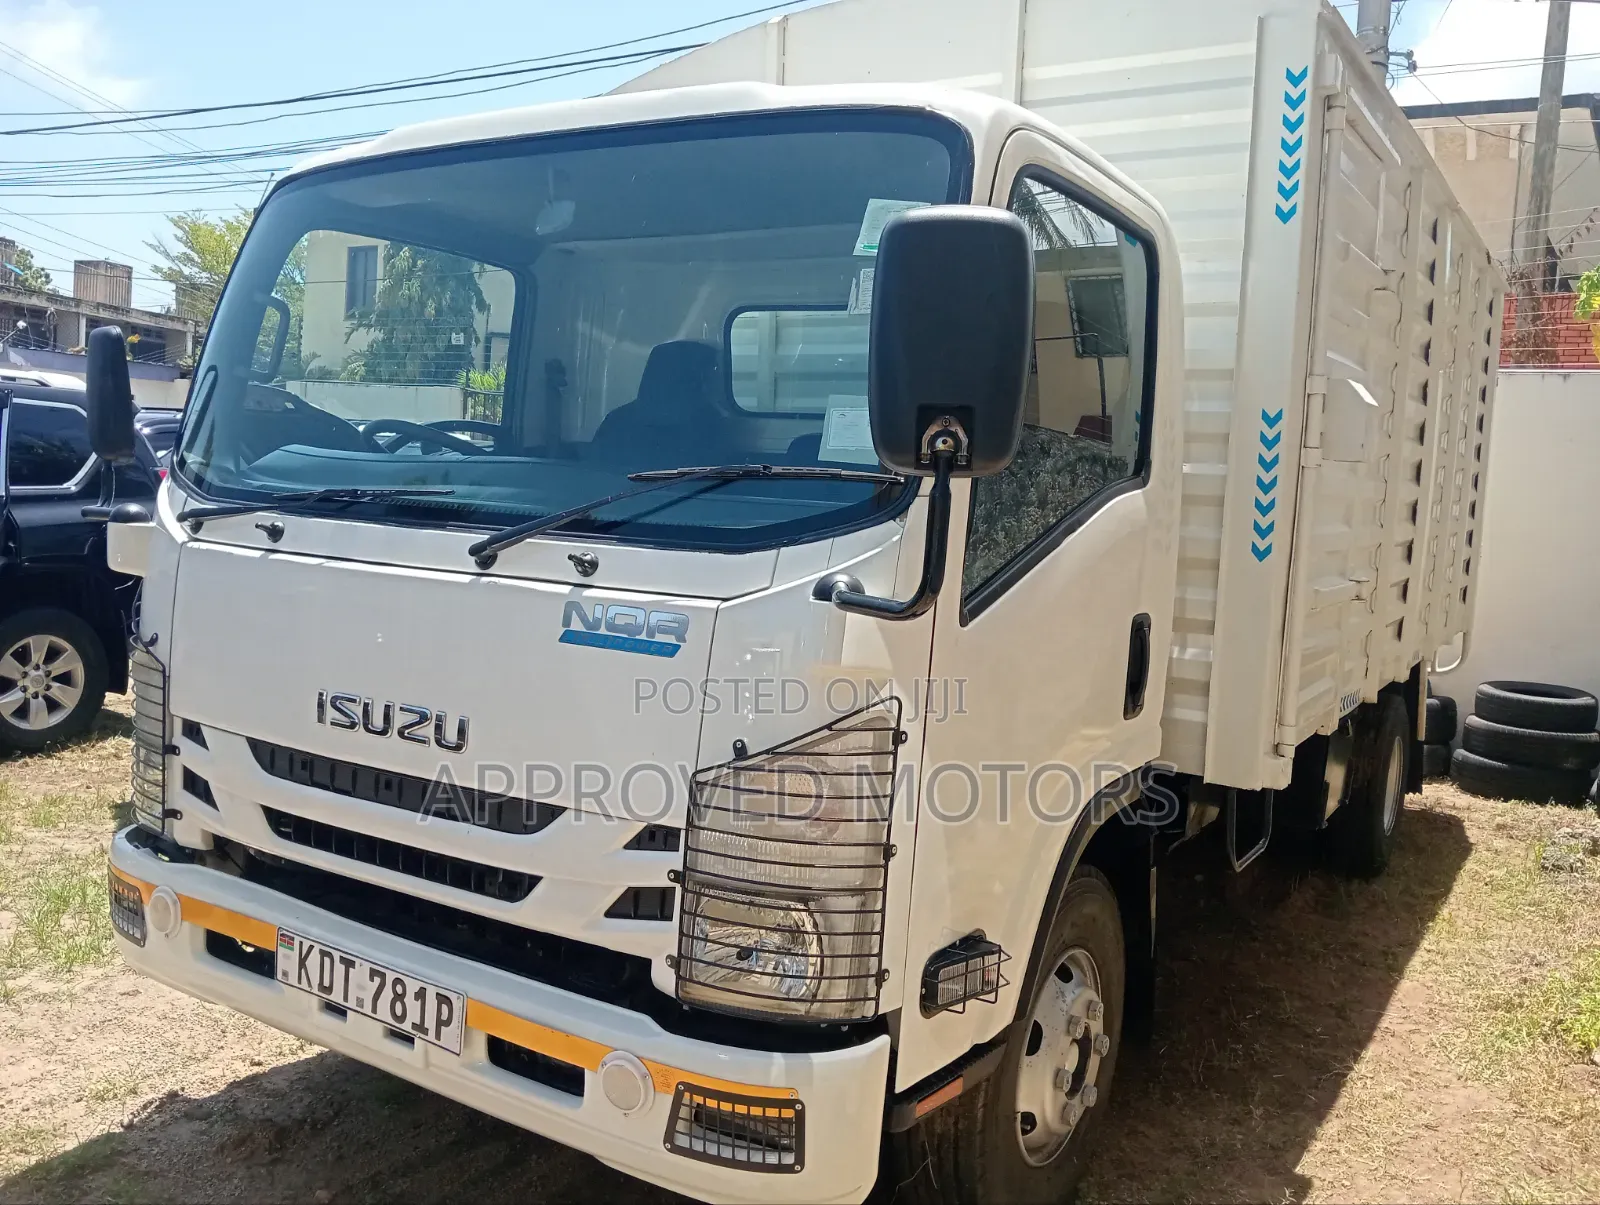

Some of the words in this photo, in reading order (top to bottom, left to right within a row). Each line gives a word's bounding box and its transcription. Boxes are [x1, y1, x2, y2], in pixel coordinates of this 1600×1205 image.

[562, 600, 689, 643] NQR
[316, 688, 470, 754] ISUZU
[297, 940, 356, 1004] KDT
[368, 966, 455, 1042] 781P
